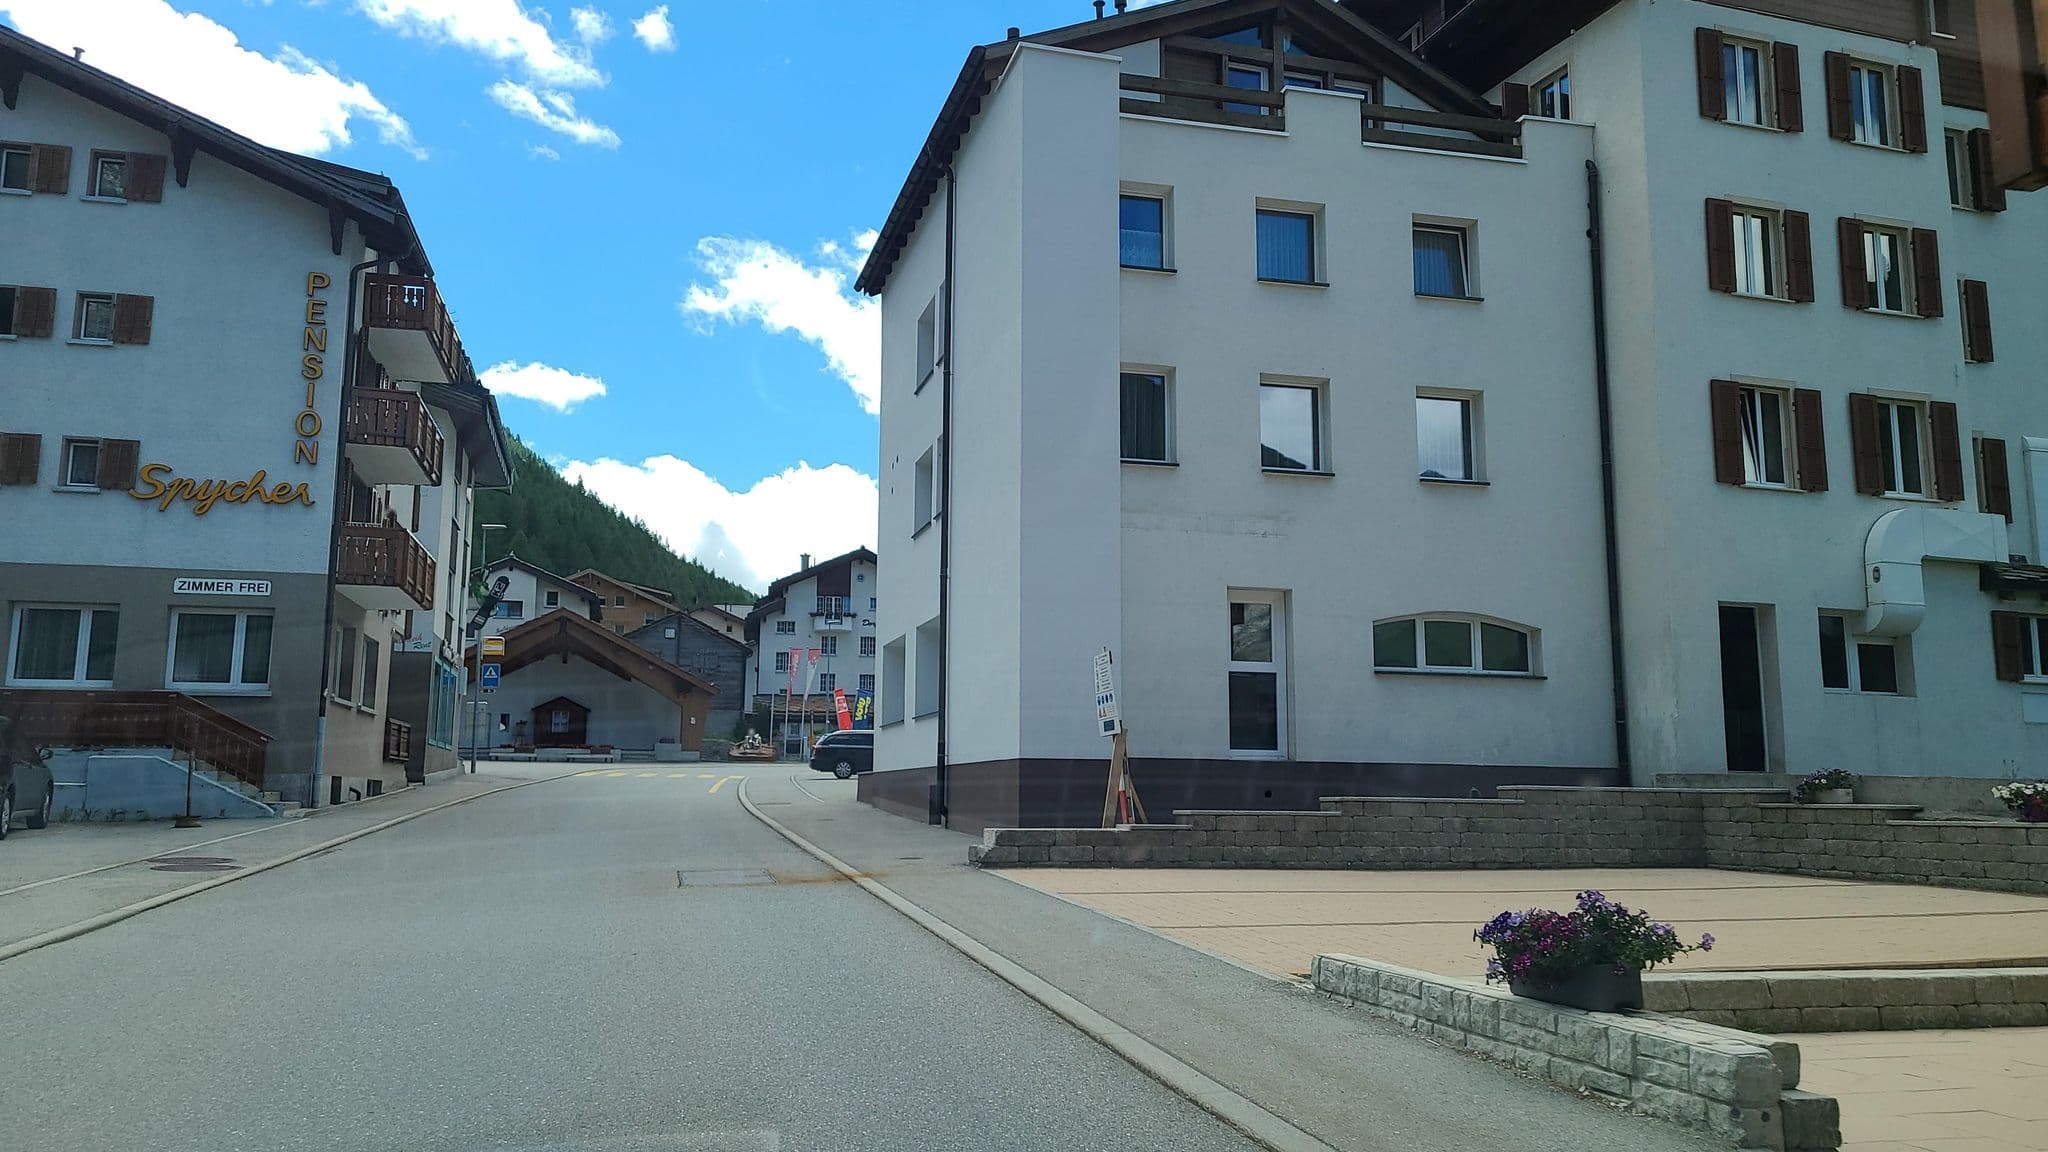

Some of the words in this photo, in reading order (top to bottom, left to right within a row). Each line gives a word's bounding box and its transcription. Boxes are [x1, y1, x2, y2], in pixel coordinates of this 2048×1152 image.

[294, 271, 331, 465] PENSION
[129, 463, 316, 516] Spycher
[177, 579, 234, 593] ZIMMER
[238, 581, 269, 594] FREI
